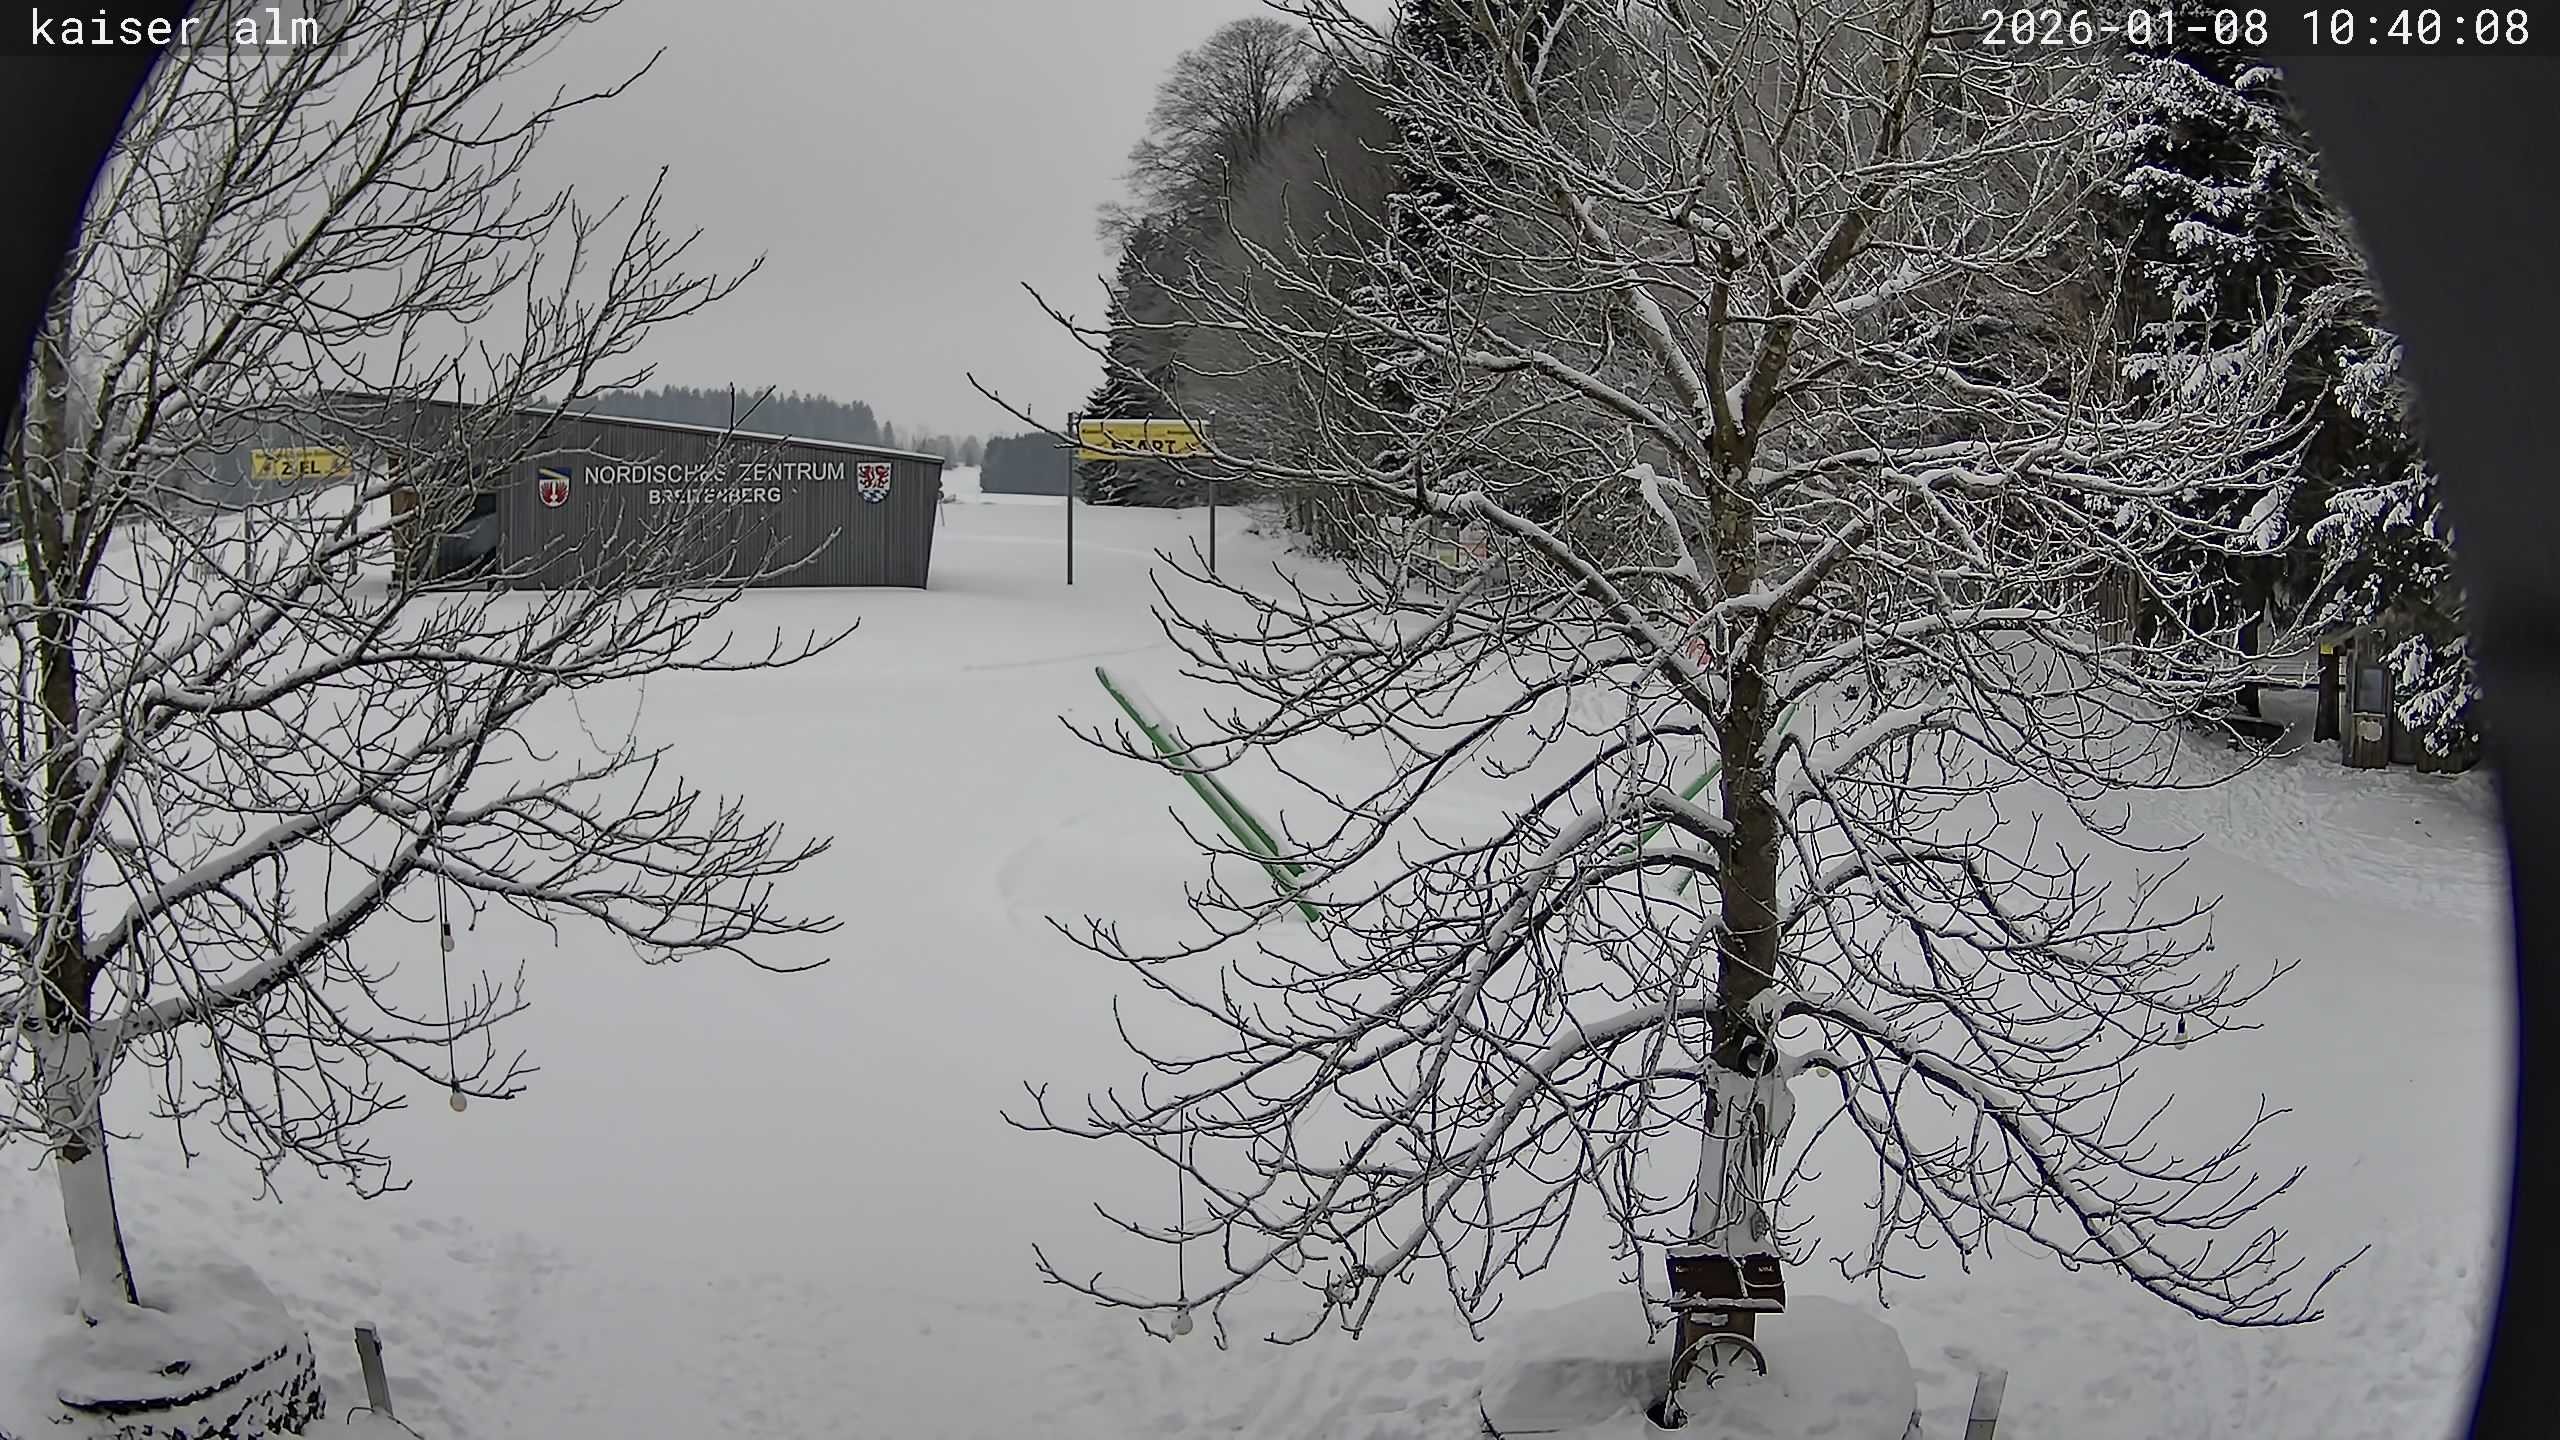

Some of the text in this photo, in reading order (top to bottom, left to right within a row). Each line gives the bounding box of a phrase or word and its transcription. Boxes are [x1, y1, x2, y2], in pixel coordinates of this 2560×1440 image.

[281, 460, 321, 475] ZEL
[738, 461, 845, 481] ZENTRUM
[648, 487, 782, 504] BREITENBERG
